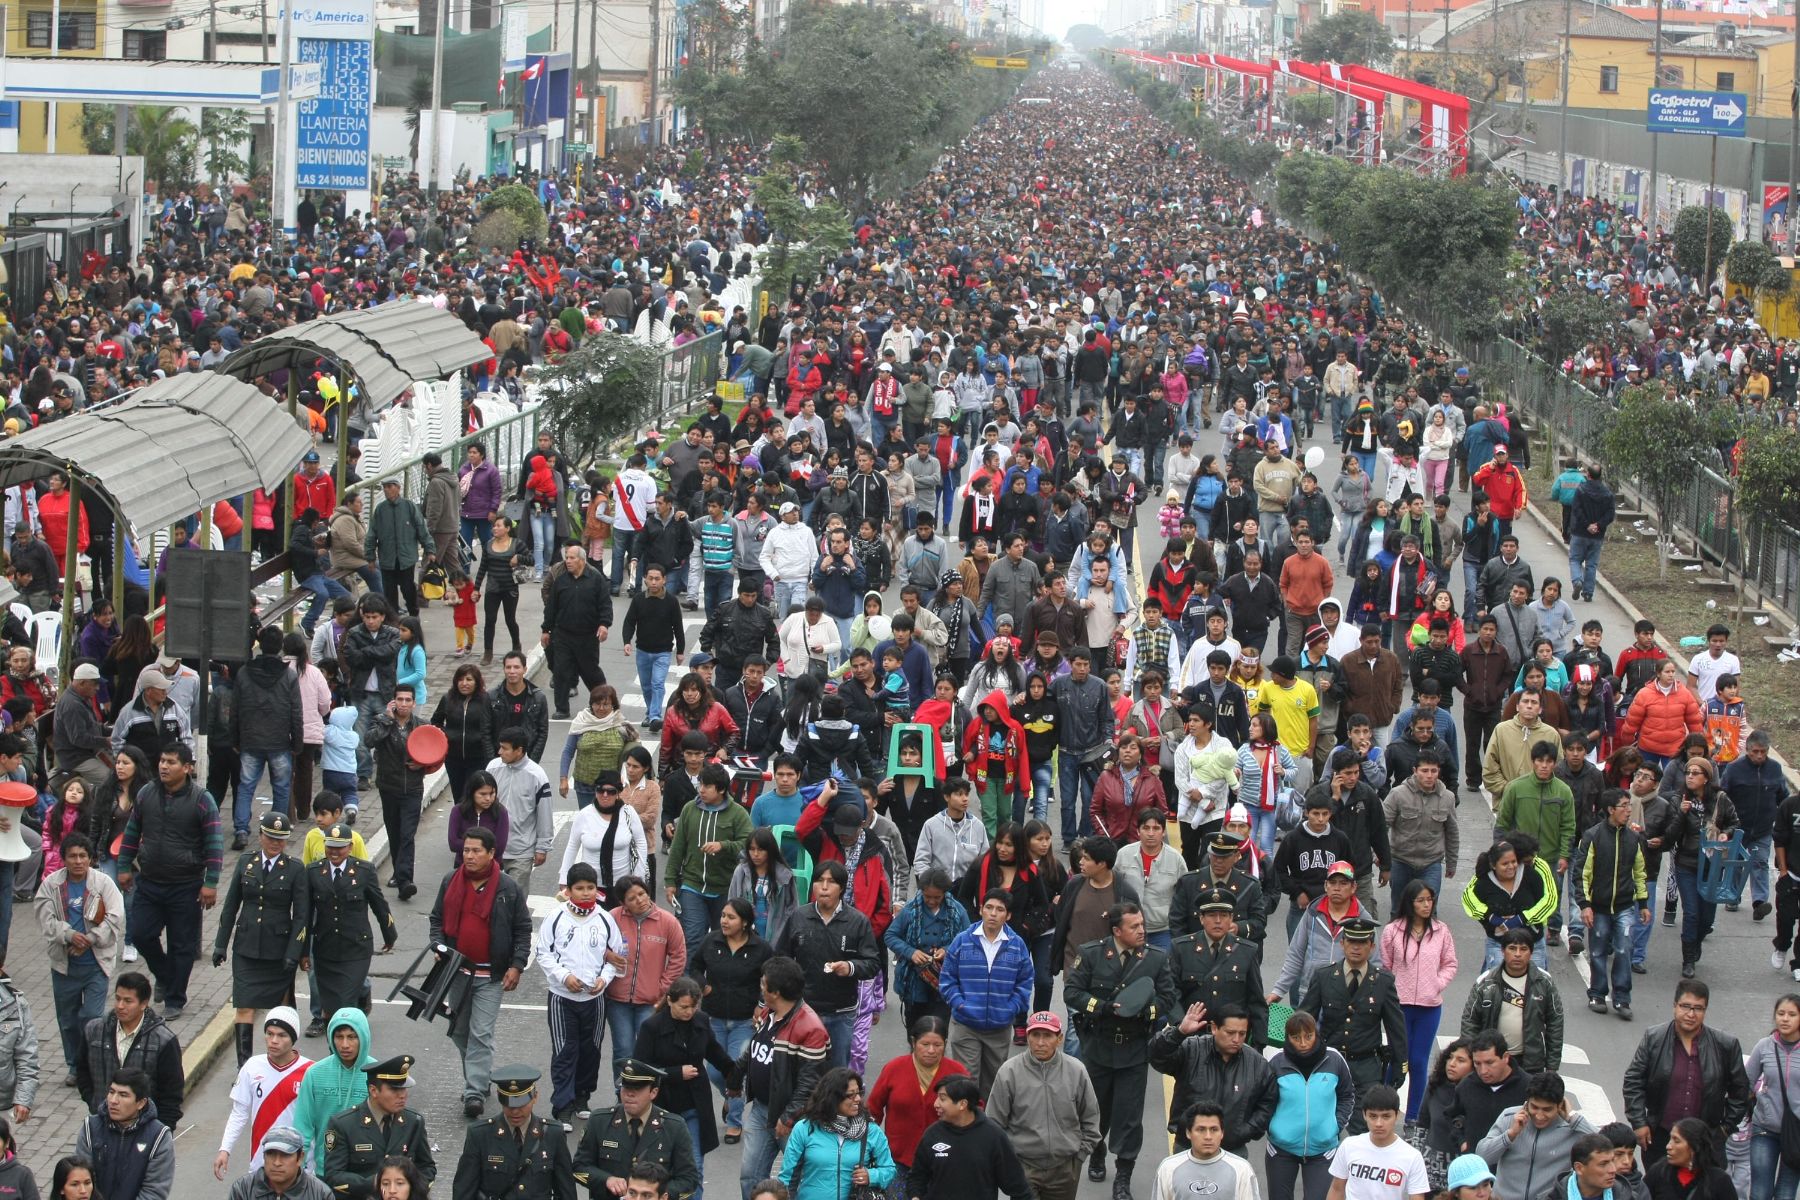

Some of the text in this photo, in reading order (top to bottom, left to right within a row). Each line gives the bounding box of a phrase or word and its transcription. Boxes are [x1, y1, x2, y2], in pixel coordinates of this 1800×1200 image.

[301, 41, 318, 55] GAS
[319, 42, 329, 56] 97
[300, 100, 319, 114] GLP
[1650, 93, 1713, 108] Gaspetrol
[300, 116, 367, 130] LLANTERIA
[1658, 115, 1700, 123] GASOLINAS
[307, 131, 360, 145] LAVADO
[298, 148, 367, 166] BIENVENIDOS
[298, 174, 366, 186] LAS 24 HORAS
[626, 484, 635, 501] 9
[1299, 849, 1336, 871] GAP
[750, 1039, 775, 1065] USA
[256, 1082, 263, 1098] 6
[1350, 1163, 1386, 1183] CIRCA
